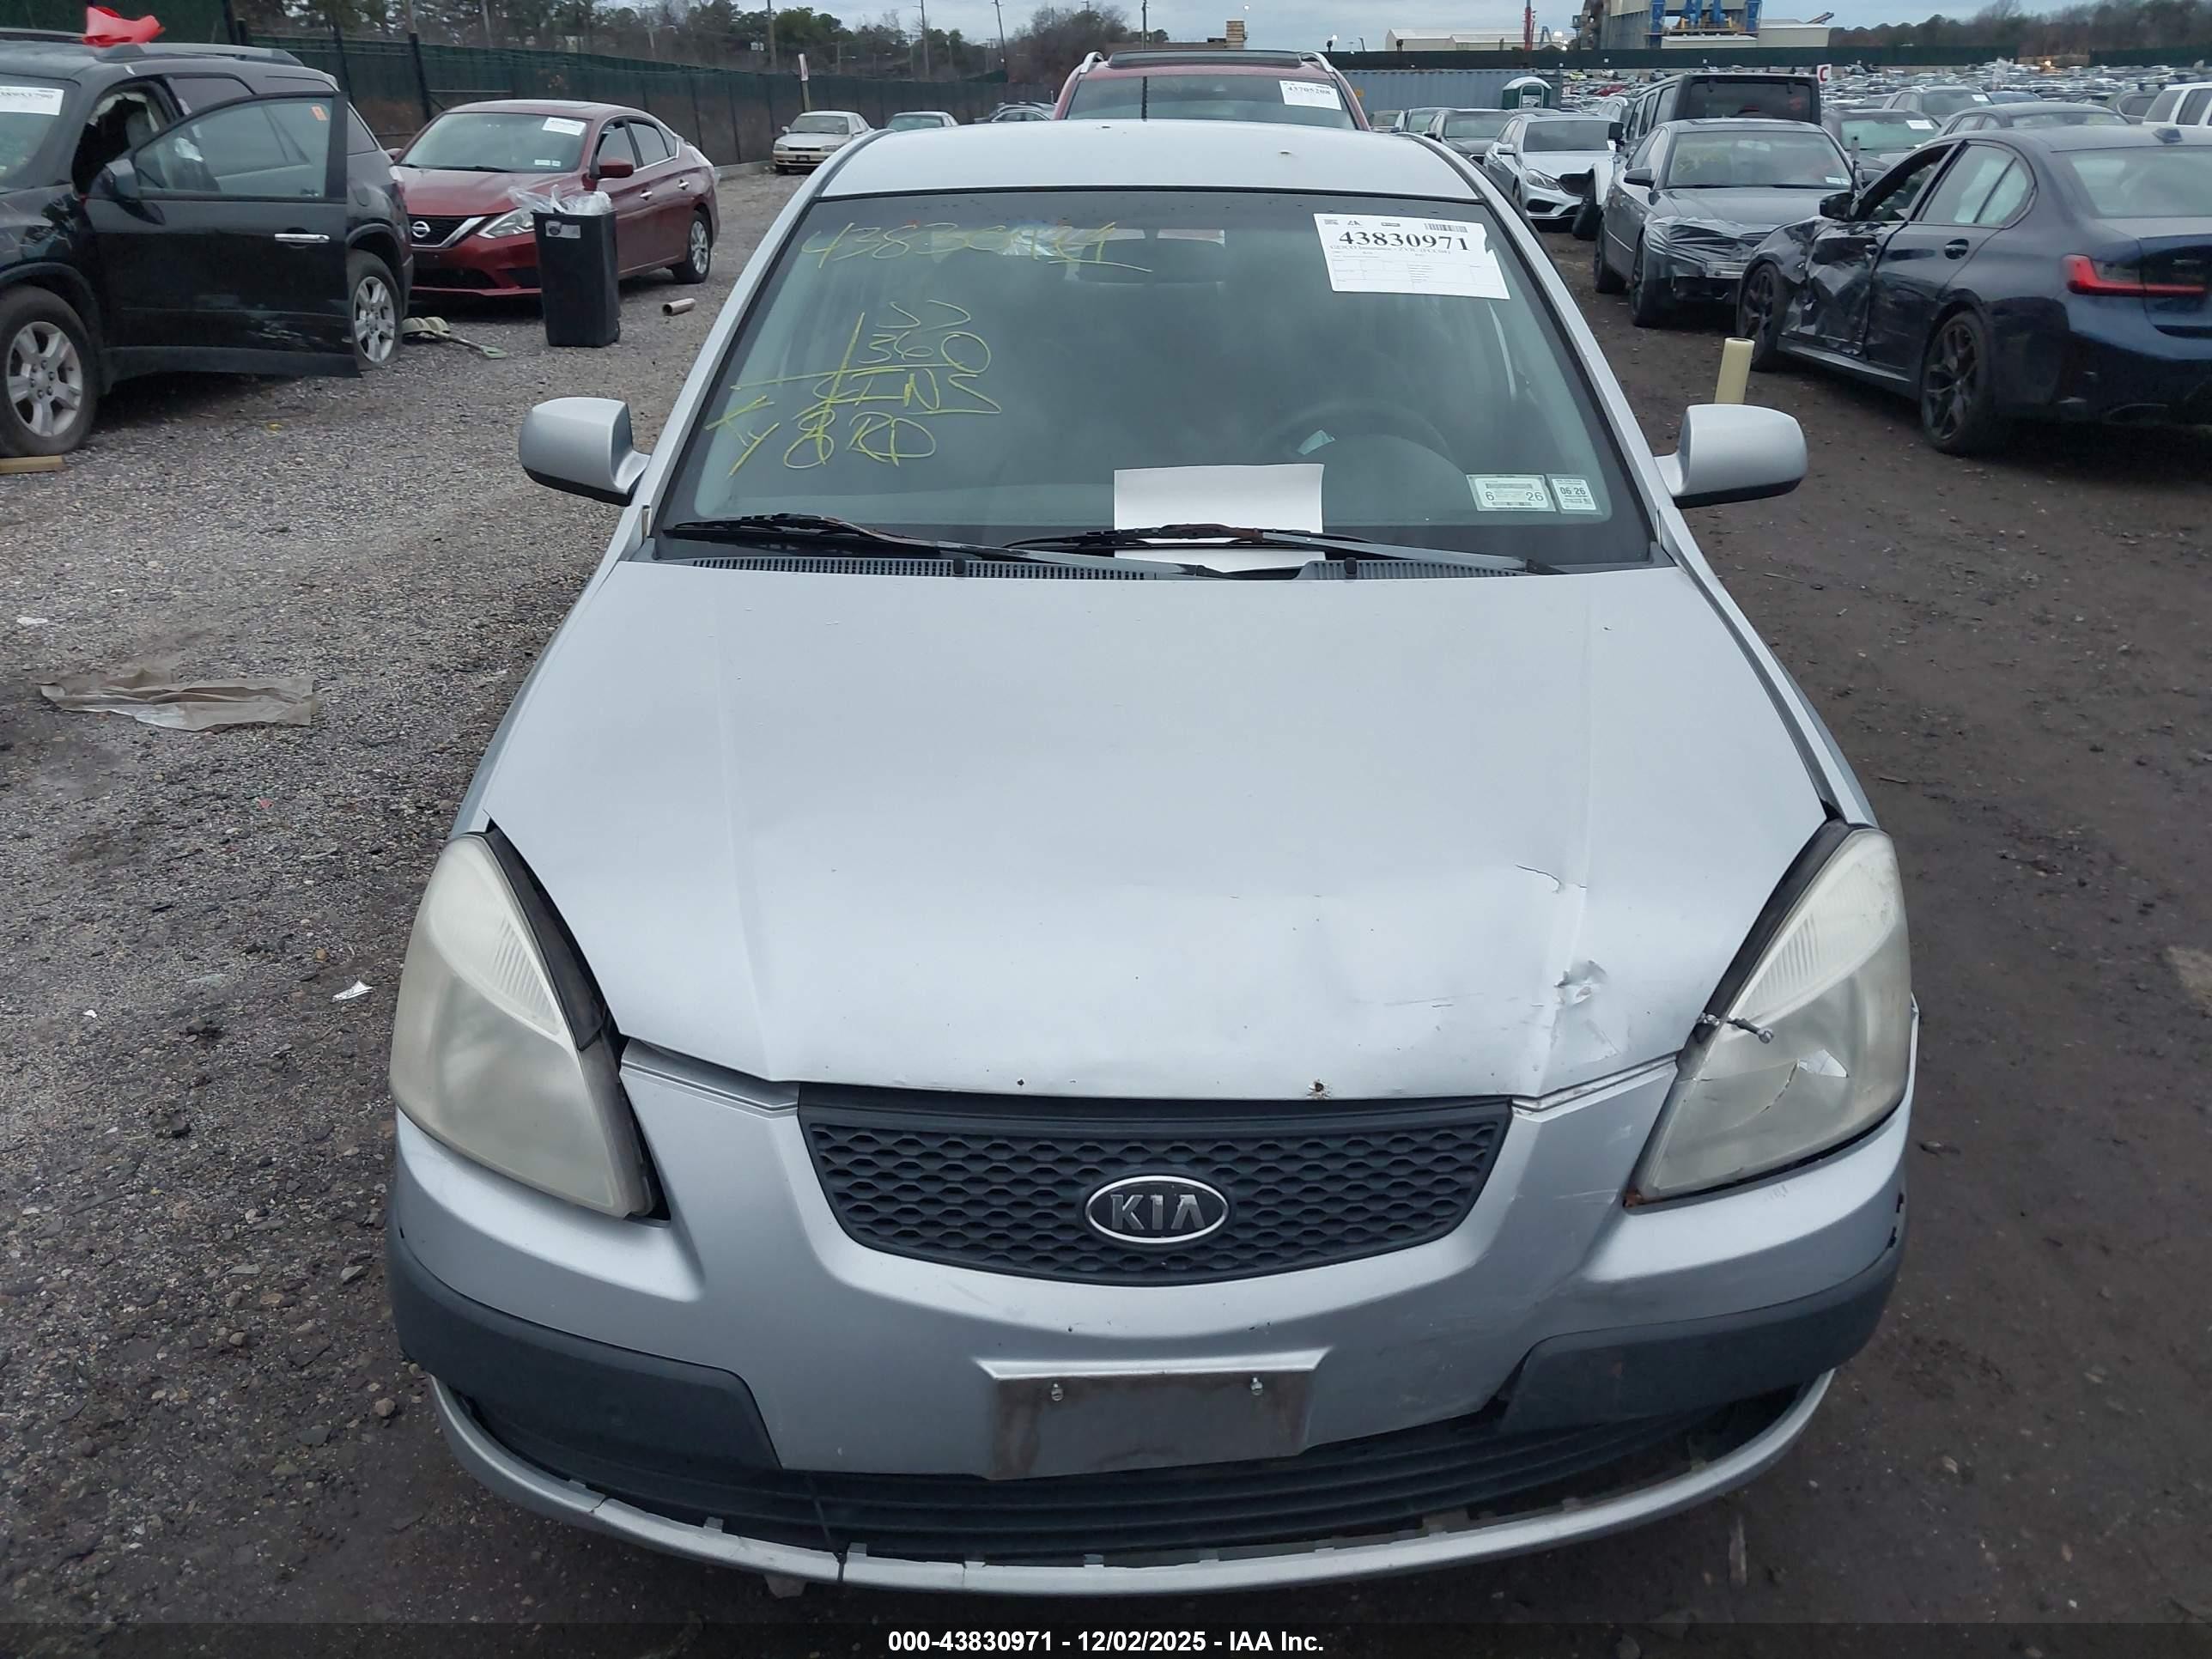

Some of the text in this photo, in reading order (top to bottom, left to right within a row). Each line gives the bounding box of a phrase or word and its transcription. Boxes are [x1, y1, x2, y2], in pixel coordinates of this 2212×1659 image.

[1820, 66, 1829, 82] C
[1340, 231, 1471, 251] 43830971
[1486, 491, 1544, 501] 6 26
[1110, 1194, 1206, 1230] KIA
